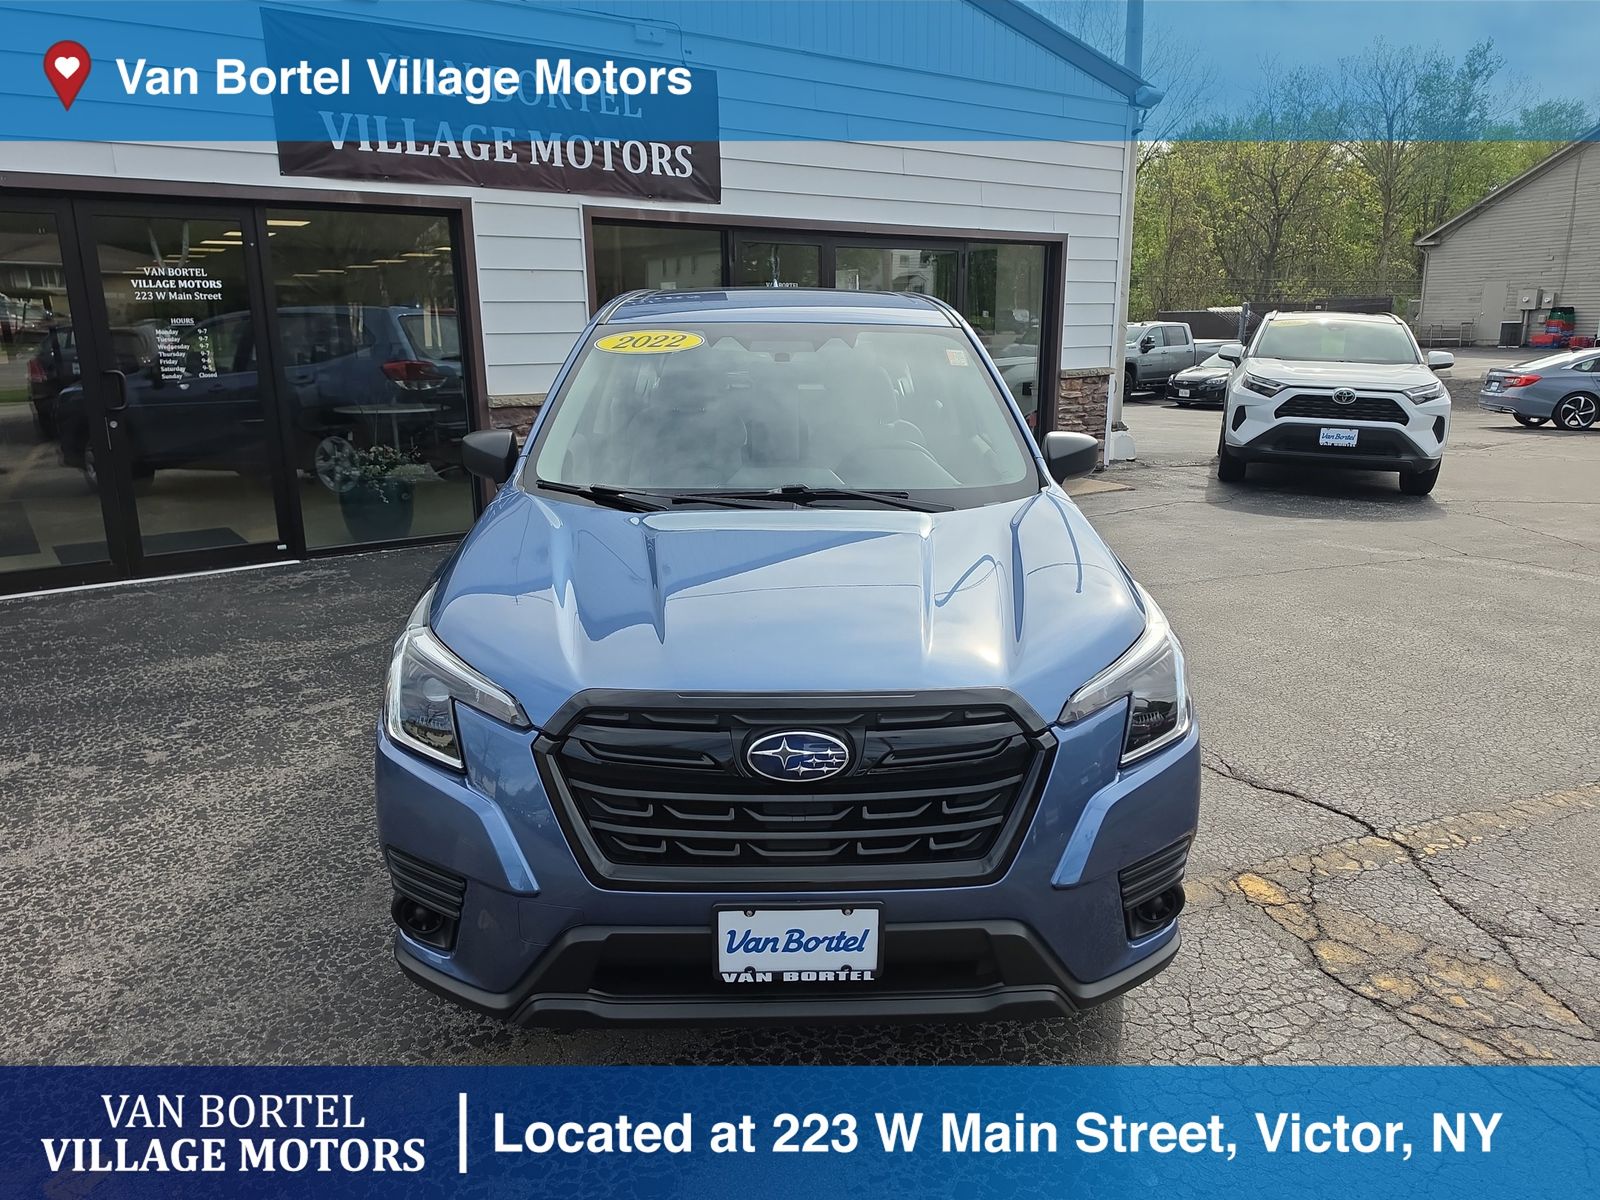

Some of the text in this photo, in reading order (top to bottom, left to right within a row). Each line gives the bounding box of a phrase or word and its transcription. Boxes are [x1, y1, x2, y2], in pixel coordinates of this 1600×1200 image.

[318, 110, 693, 178] VILLAGE MOTORS
[143, 268, 208, 277] VAN BORTEL
[131, 280, 223, 289] VILLAGE MOTORS
[135, 291, 222, 300] 223 W Main Street
[170, 317, 195, 325] HOURS
[612, 335, 687, 349] 2022
[726, 928, 870, 954] Van Bortel
[721, 970, 875, 983] VAN BORTEL
